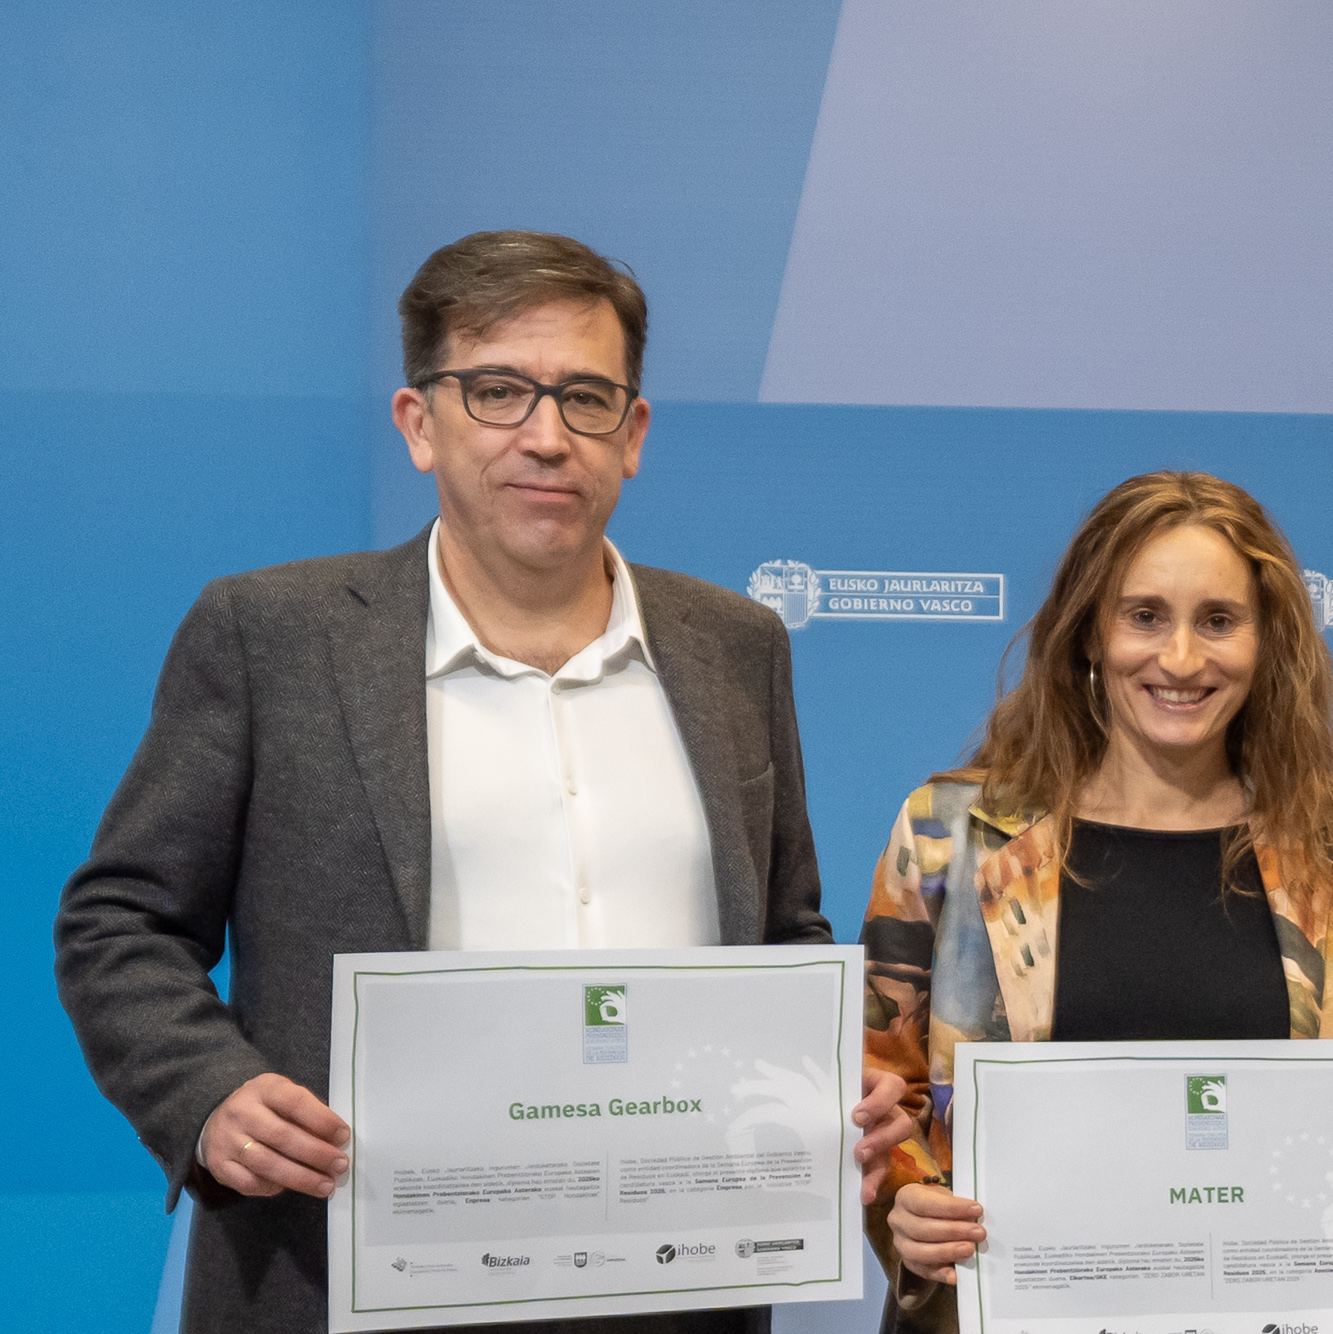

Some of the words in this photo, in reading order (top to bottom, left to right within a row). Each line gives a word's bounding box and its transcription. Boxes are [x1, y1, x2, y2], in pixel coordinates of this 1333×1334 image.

[828, 577, 879, 592] EUSKO
[883, 579, 984, 594] JAURLARITZA
[828, 597, 914, 612] GOBIERNO
[920, 599, 972, 612] VASCO
[508, 1099, 602, 1121] Gamesa
[608, 1095, 702, 1118] Gearbox
[1170, 1186, 1245, 1205] MATER
[677, 1243, 715, 1256] ihobe
[489, 1255, 530, 1268] Bizkaia
